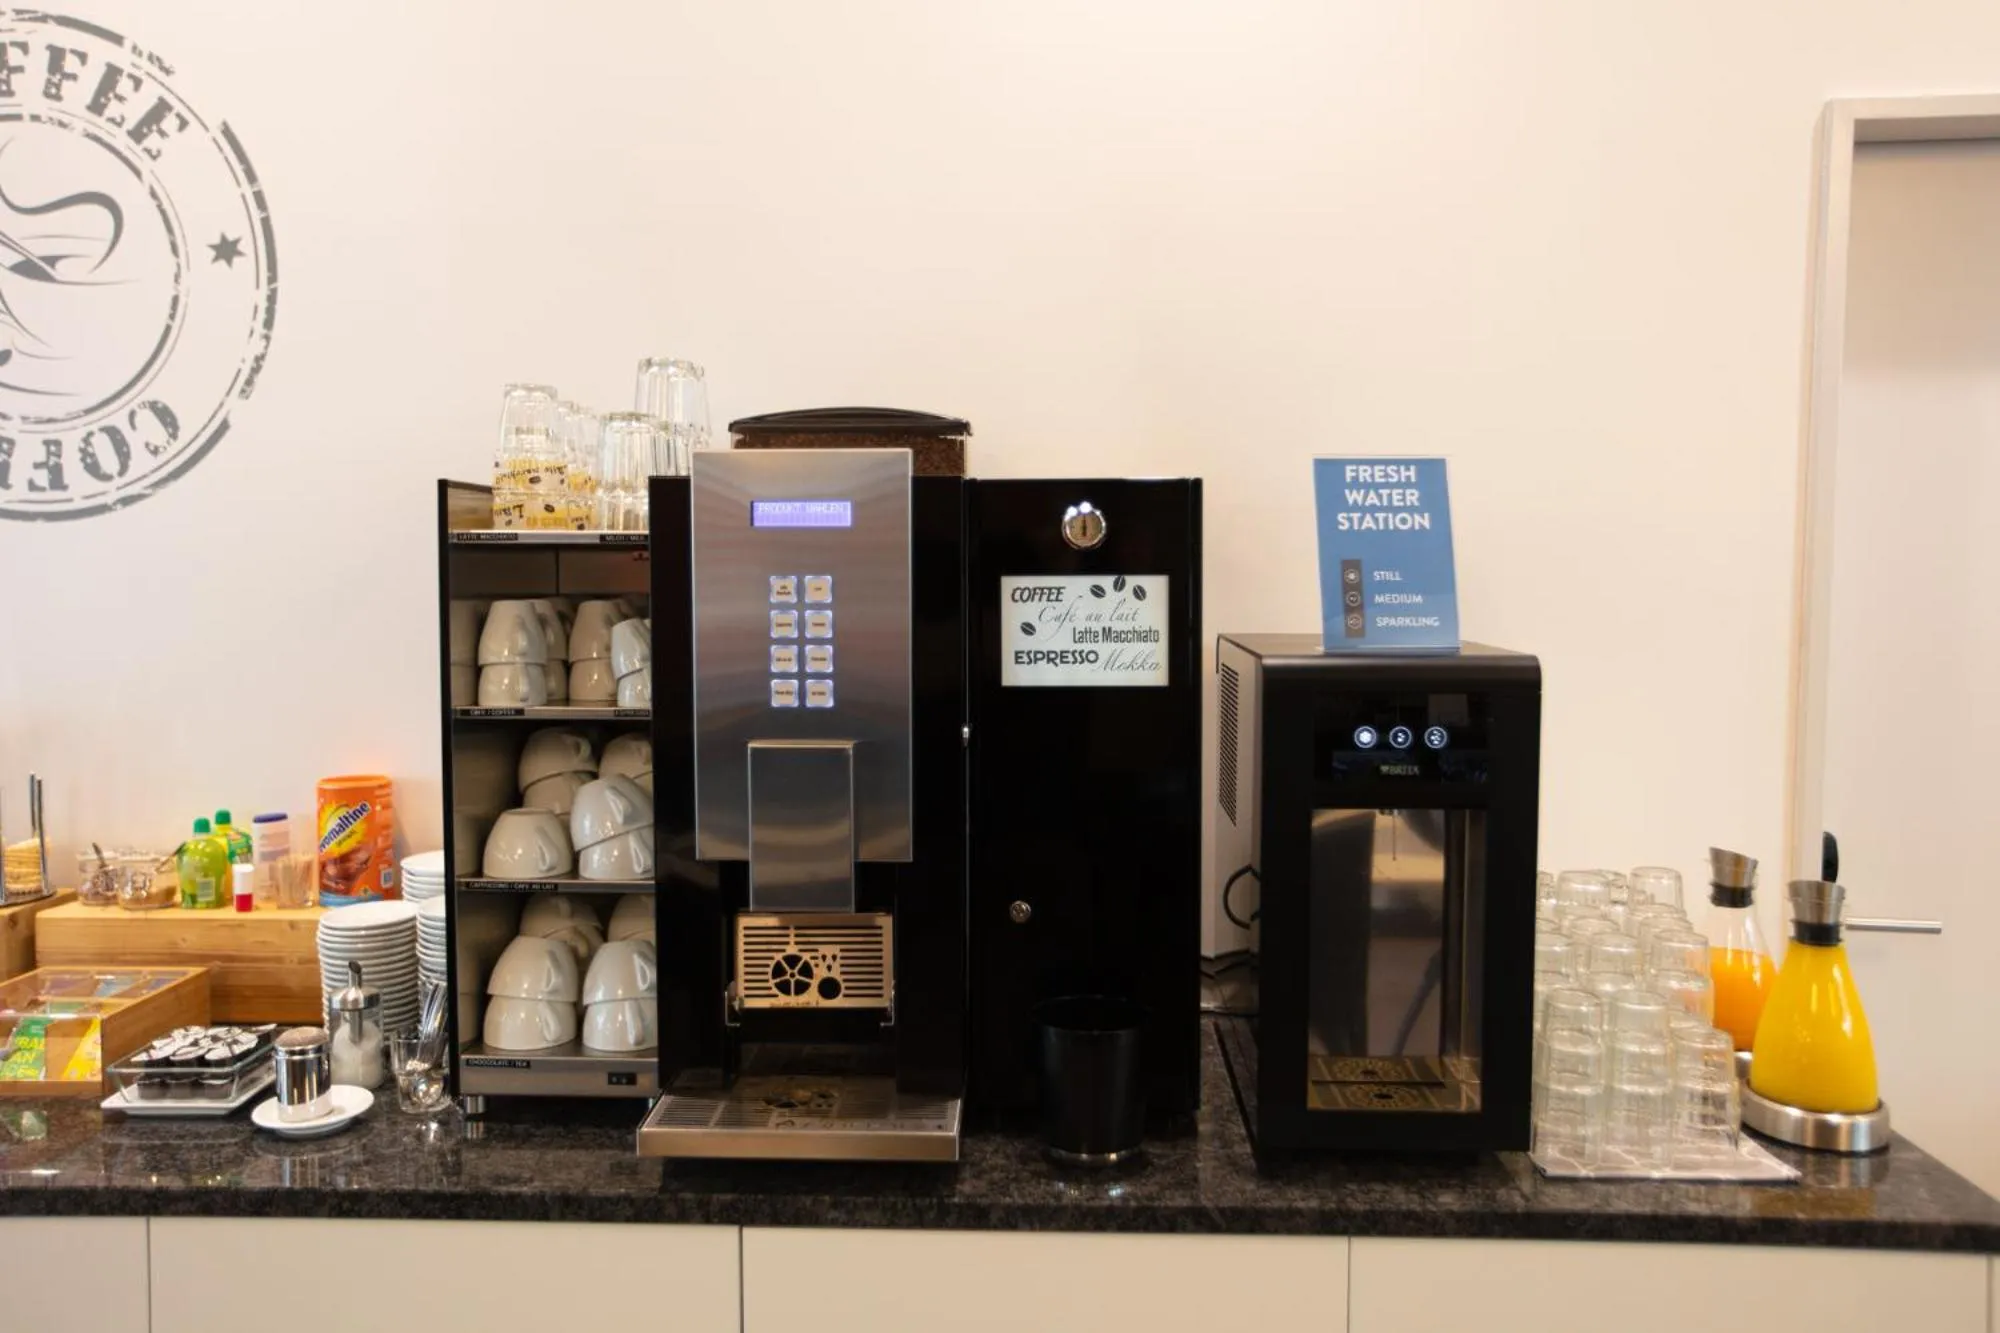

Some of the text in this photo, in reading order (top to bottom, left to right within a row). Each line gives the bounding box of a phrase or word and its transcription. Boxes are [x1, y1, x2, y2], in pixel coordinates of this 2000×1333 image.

[1345, 464, 1416, 483] FRESH
[1344, 488, 1420, 507] WATER
[1337, 512, 1430, 531] STATION
[1373, 571, 1402, 581] STILL
[1011, 586, 1066, 603] COFFEE
[1374, 594, 1423, 604] MEDIUM
[1085, 613, 1102, 623] au
[1109, 598, 1140, 622] lait
[1376, 616, 1439, 627] SPARKLING
[1072, 625, 1160, 644] Latte Macchiato
[1014, 649, 1162, 672] ESPRESSO Mokka
